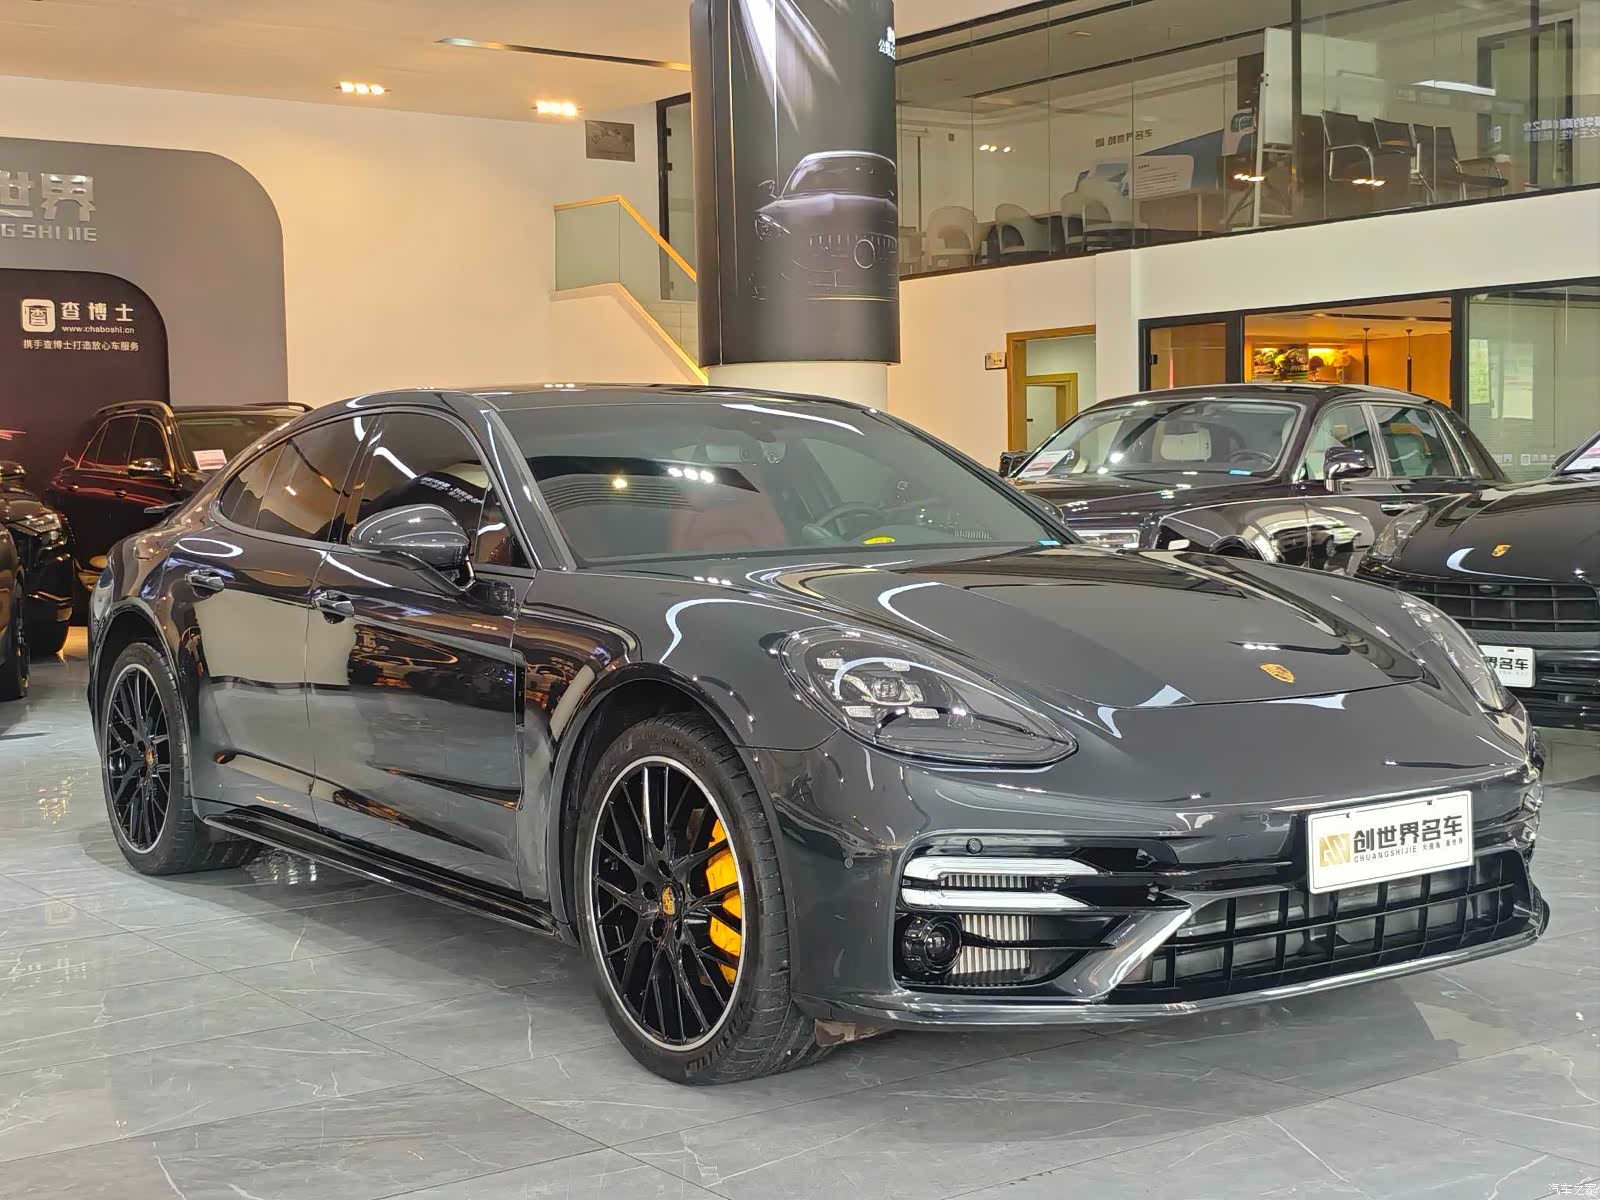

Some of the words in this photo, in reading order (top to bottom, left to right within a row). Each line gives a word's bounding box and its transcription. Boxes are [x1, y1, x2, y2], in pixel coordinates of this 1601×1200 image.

[60, 301, 134, 322] 查博士
[62, 325, 135, 335] www.chaboshi.cn
[23, 339, 139, 352] 携手查博士打造放心车服务
[1353, 814, 1463, 853] 创世界名车
[1353, 845, 1418, 863] CHUANGSHIJIE
